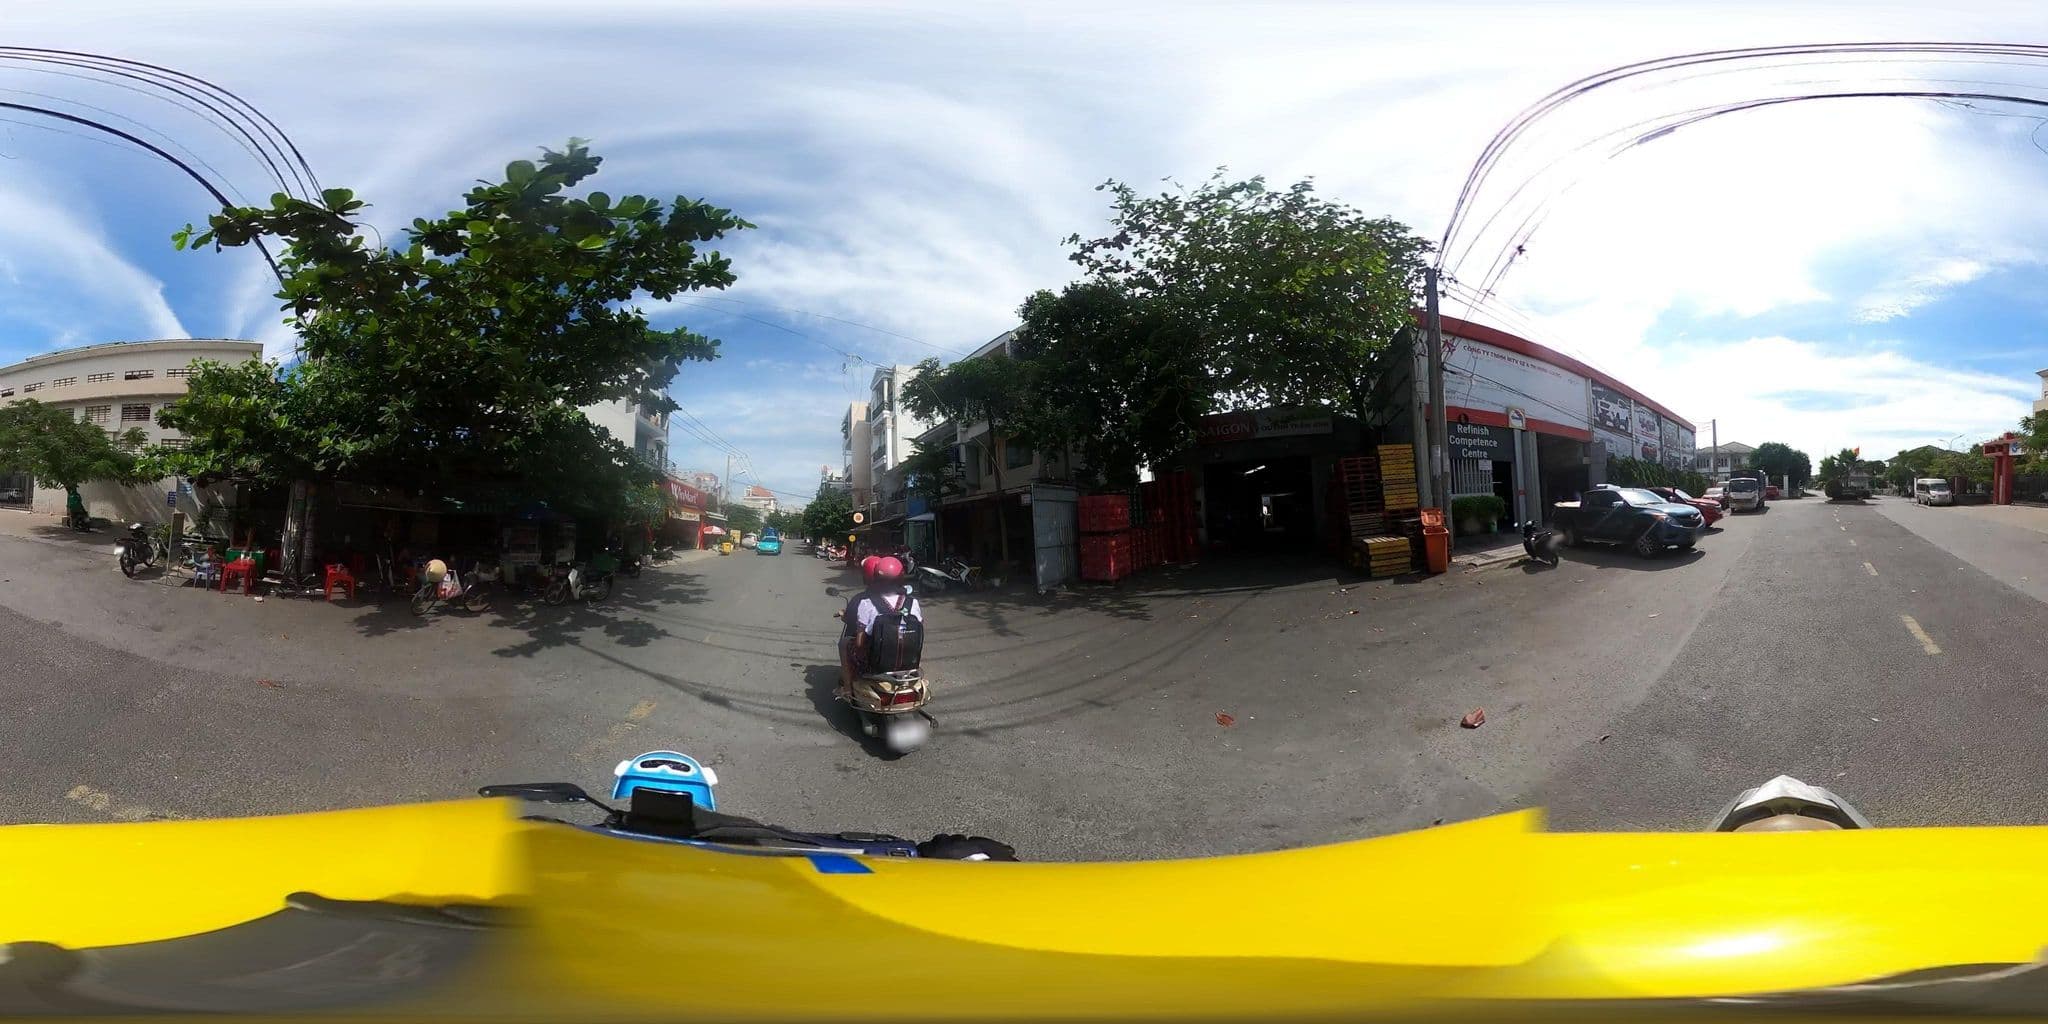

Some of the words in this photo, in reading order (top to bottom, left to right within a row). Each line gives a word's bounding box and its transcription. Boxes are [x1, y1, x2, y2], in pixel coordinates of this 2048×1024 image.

[1457, 424, 1490, 436] Refinish
[1449, 434, 1498, 448] Competence
[1462, 448, 1488, 459] Centre
